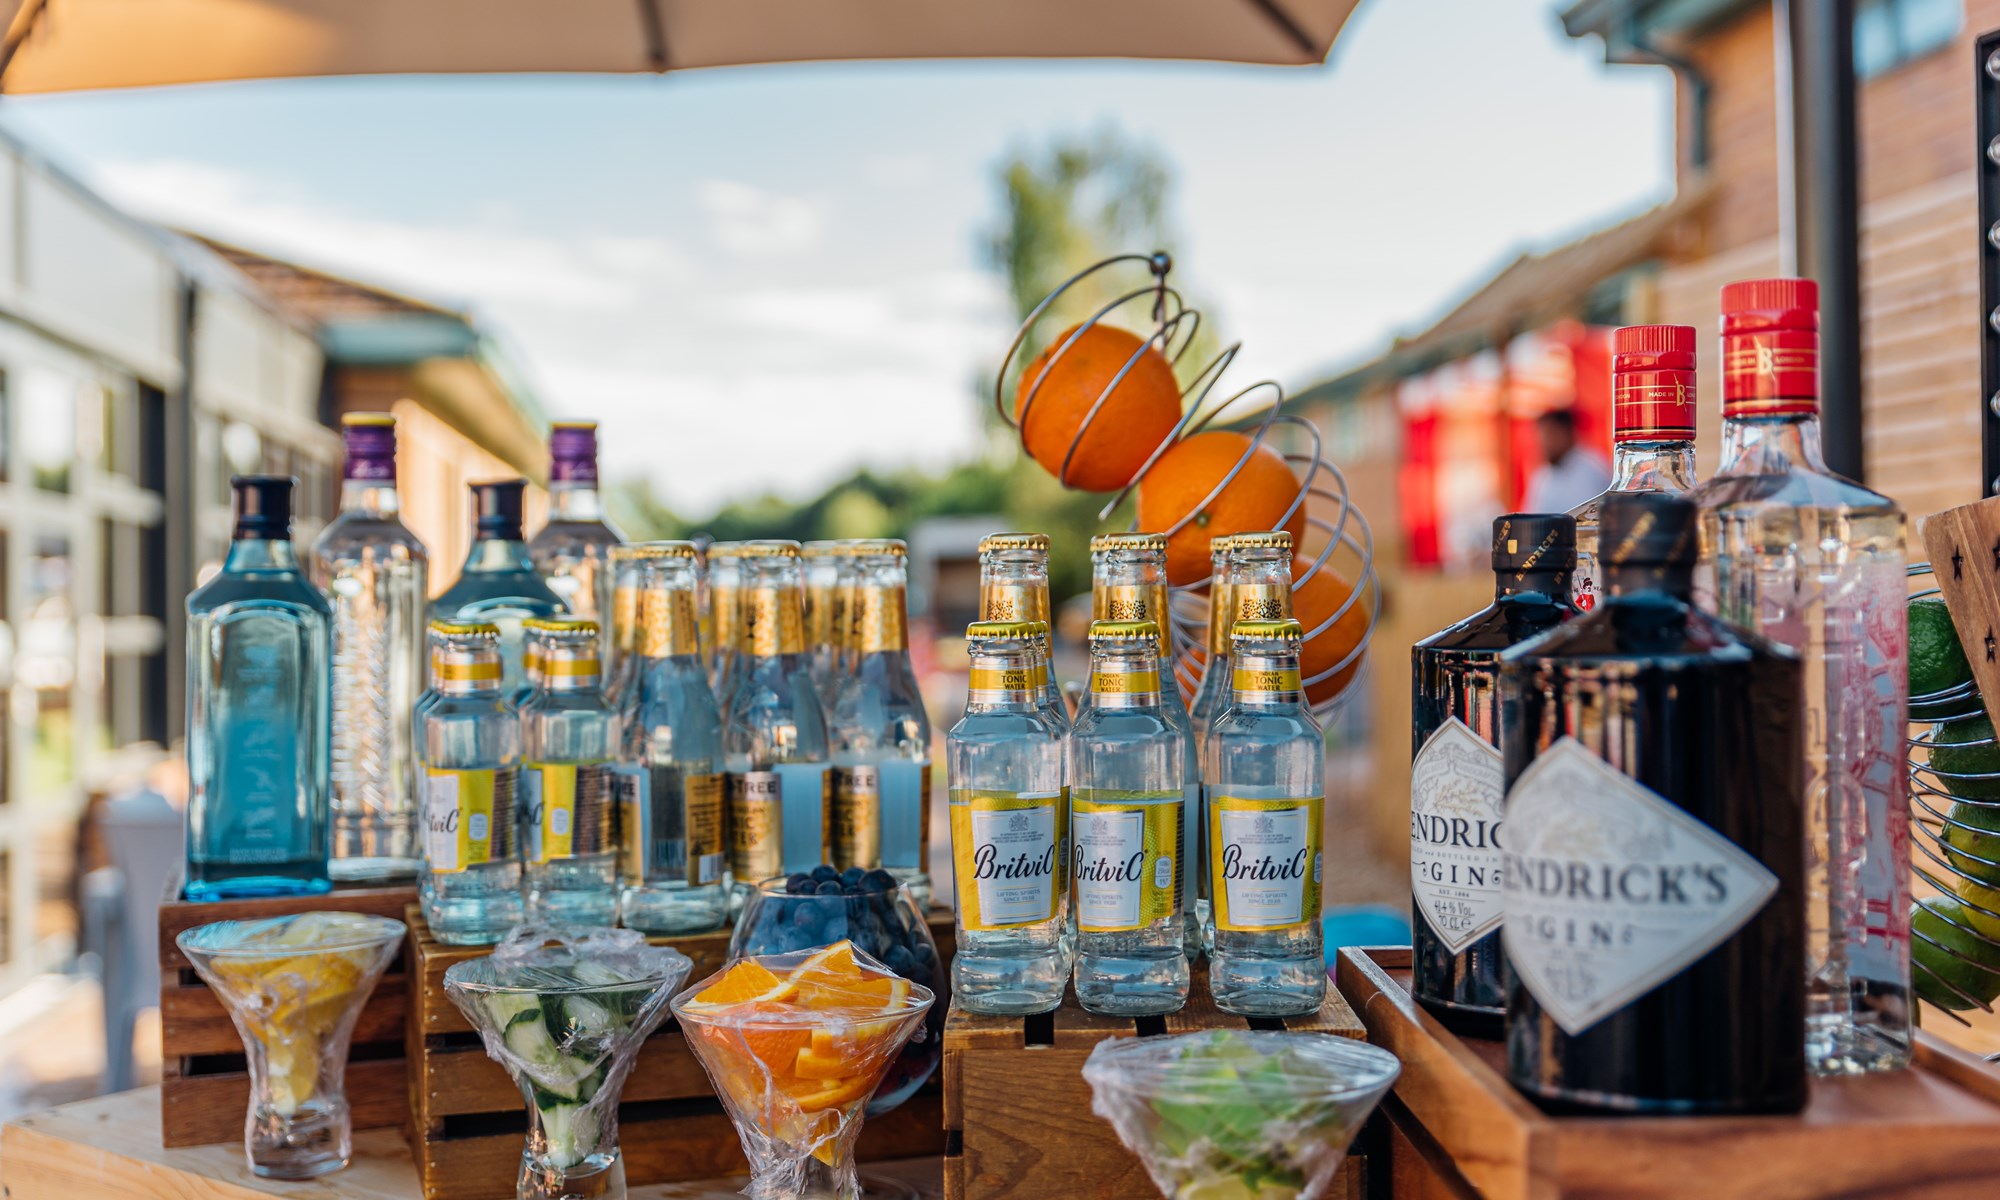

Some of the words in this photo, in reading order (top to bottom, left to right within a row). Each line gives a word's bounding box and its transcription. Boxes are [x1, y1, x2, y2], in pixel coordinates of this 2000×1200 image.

[1001, 675, 1027, 684] TONIC
[1098, 678, 1124, 687] TONIC
[1254, 676, 1284, 685] TONIC
[1431, 861, 1485, 886] GIN
